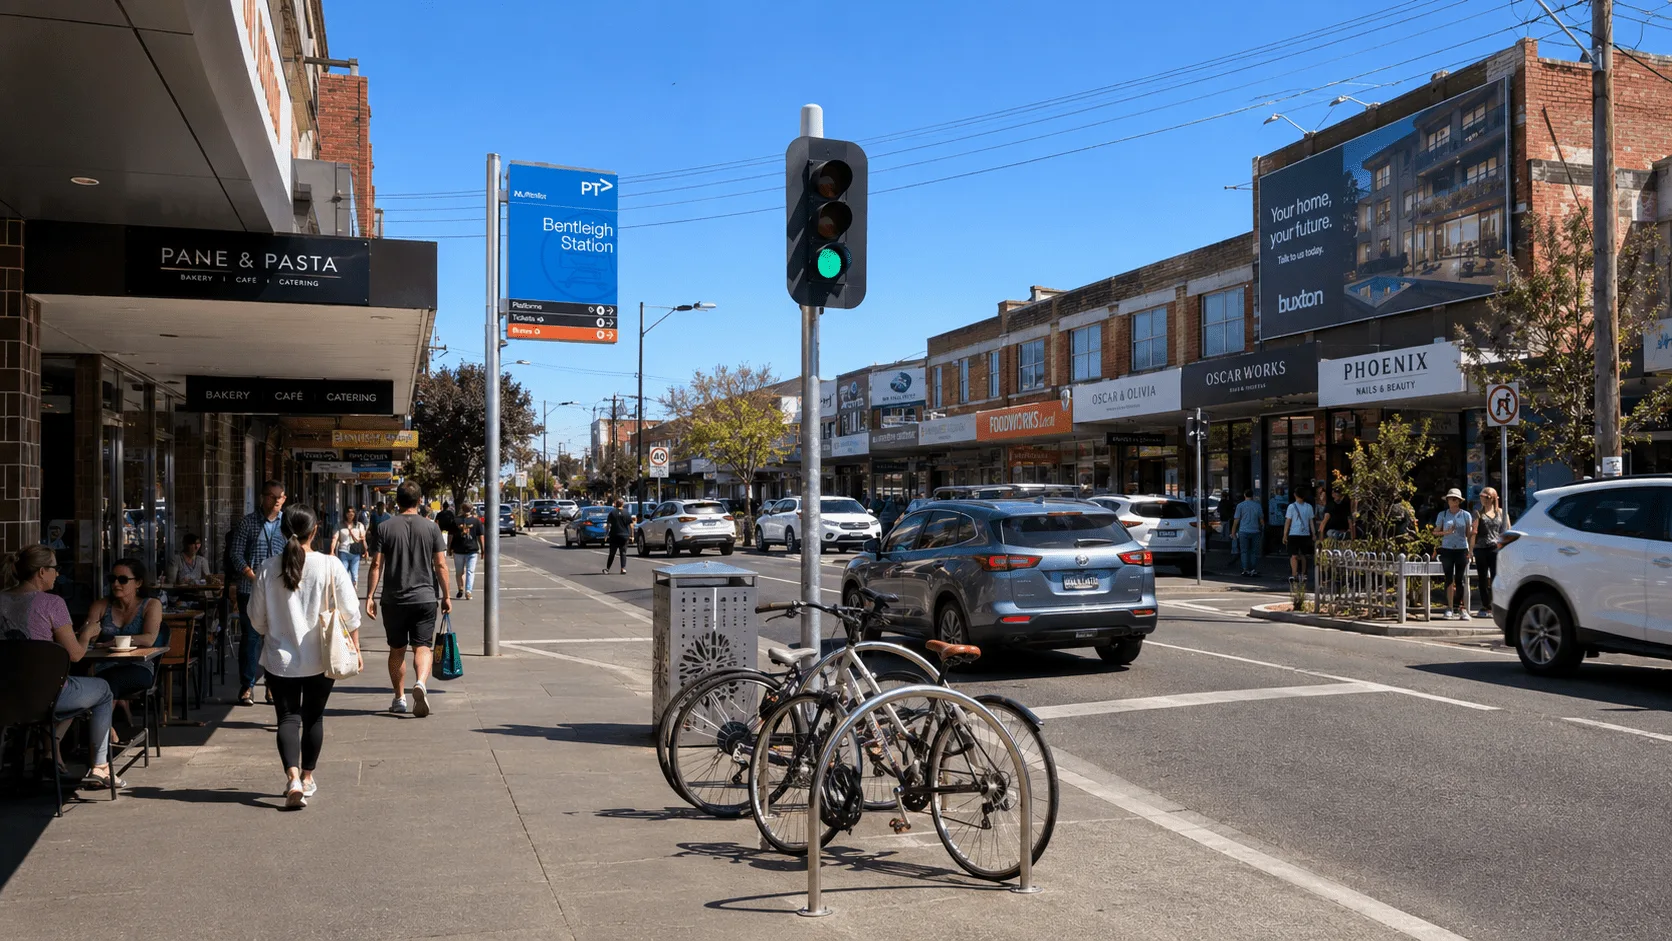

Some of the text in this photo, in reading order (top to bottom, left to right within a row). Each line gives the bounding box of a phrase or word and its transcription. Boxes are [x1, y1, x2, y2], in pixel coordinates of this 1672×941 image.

[1271, 192, 1333, 224] Your home,
[543, 217, 613, 239] Bentleigh
[1270, 215, 1333, 250] your future.
[561, 235, 613, 253] Station
[161, 247, 339, 273] PANE & PASTA
[1278, 254, 1290, 265] Talk
[1290, 253, 1296, 261] to
[1305, 245, 1324, 257] today.
[180, 274, 319, 287] BAKERY CAFÉ CATERING
[1278, 288, 1324, 314] buxton
[1206, 360, 1287, 386] OSCAR WORKS
[1343, 351, 1429, 381] PHOENIX
[205, 389, 377, 403] BAKERY CAFÉ CATERING
[1092, 385, 1156, 405] OSCAR & OLIVIA
[1355, 380, 1416, 396] NAILS & BEAUTY
[653, 452, 665, 461] 40
